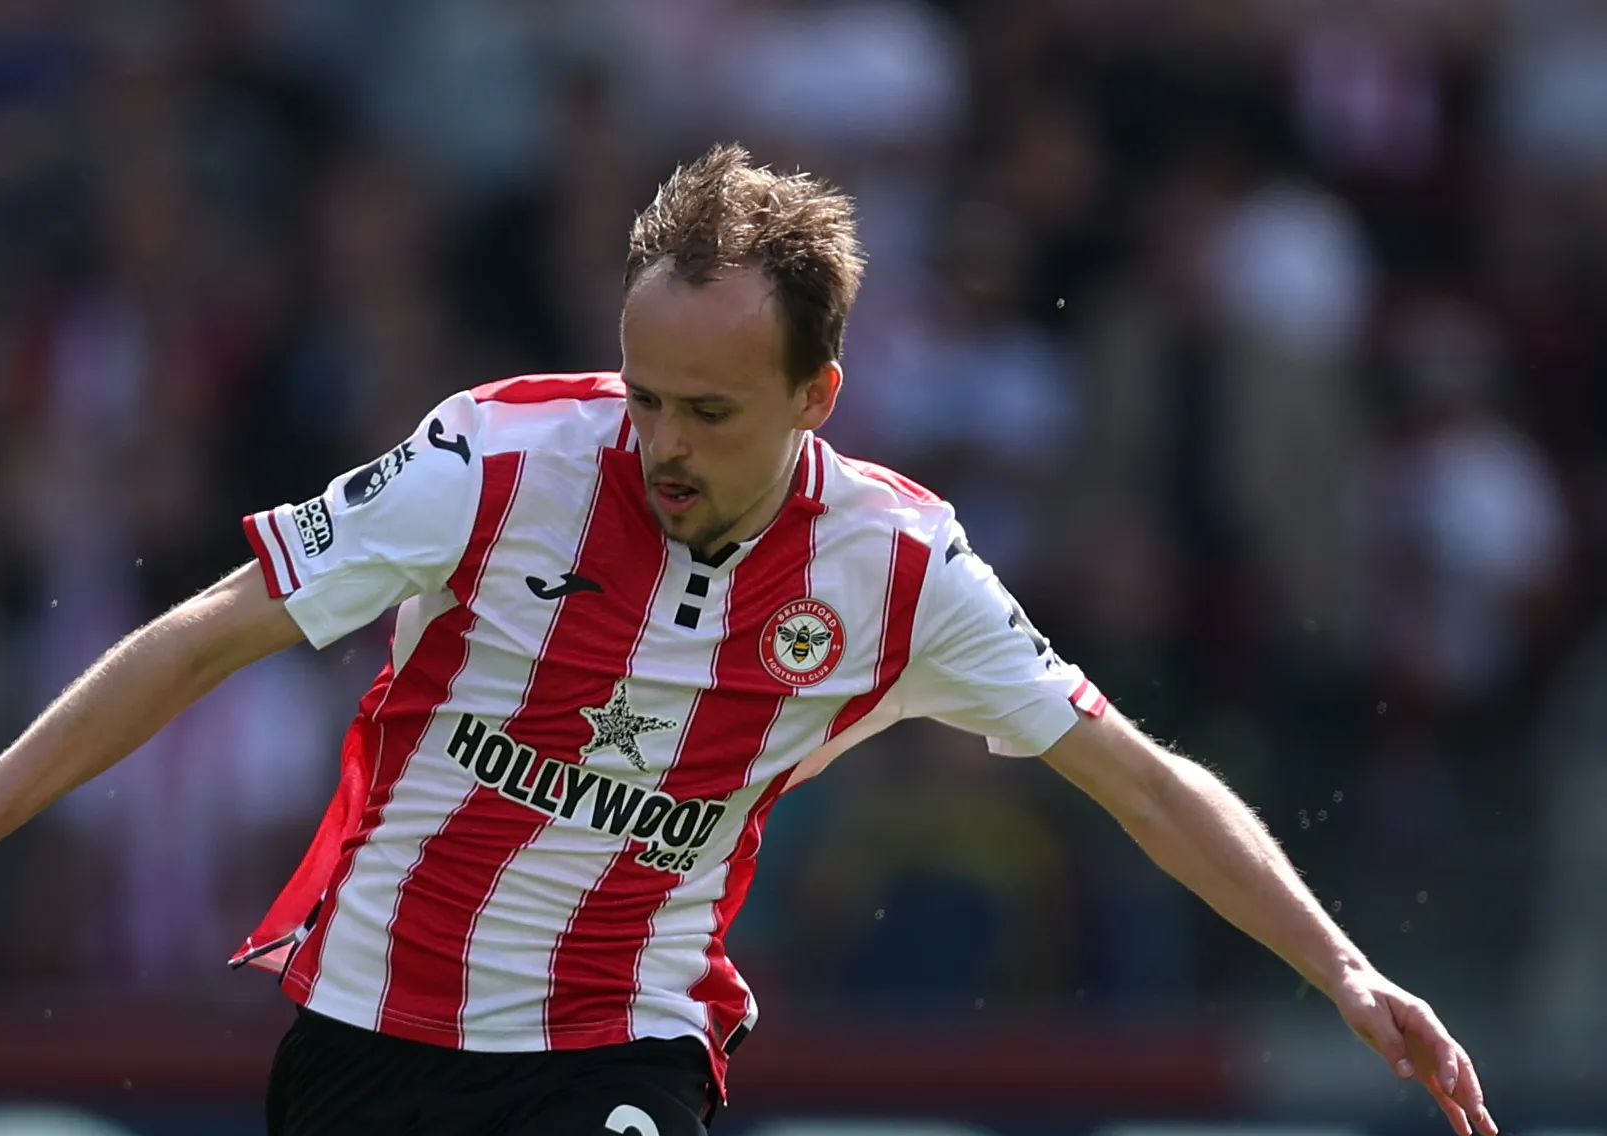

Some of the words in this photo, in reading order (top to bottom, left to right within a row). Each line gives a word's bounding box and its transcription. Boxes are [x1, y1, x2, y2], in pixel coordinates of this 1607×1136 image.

[293, 505, 320, 558] acism
[307, 500, 331, 545] oom
[777, 603, 837, 627] BRENTFORD
[767, 658, 806, 683] FOOTBALL
[808, 665, 830, 681] CLUB
[446, 712, 727, 849] HOLLYWOOD
[637, 840, 699, 872] bets
